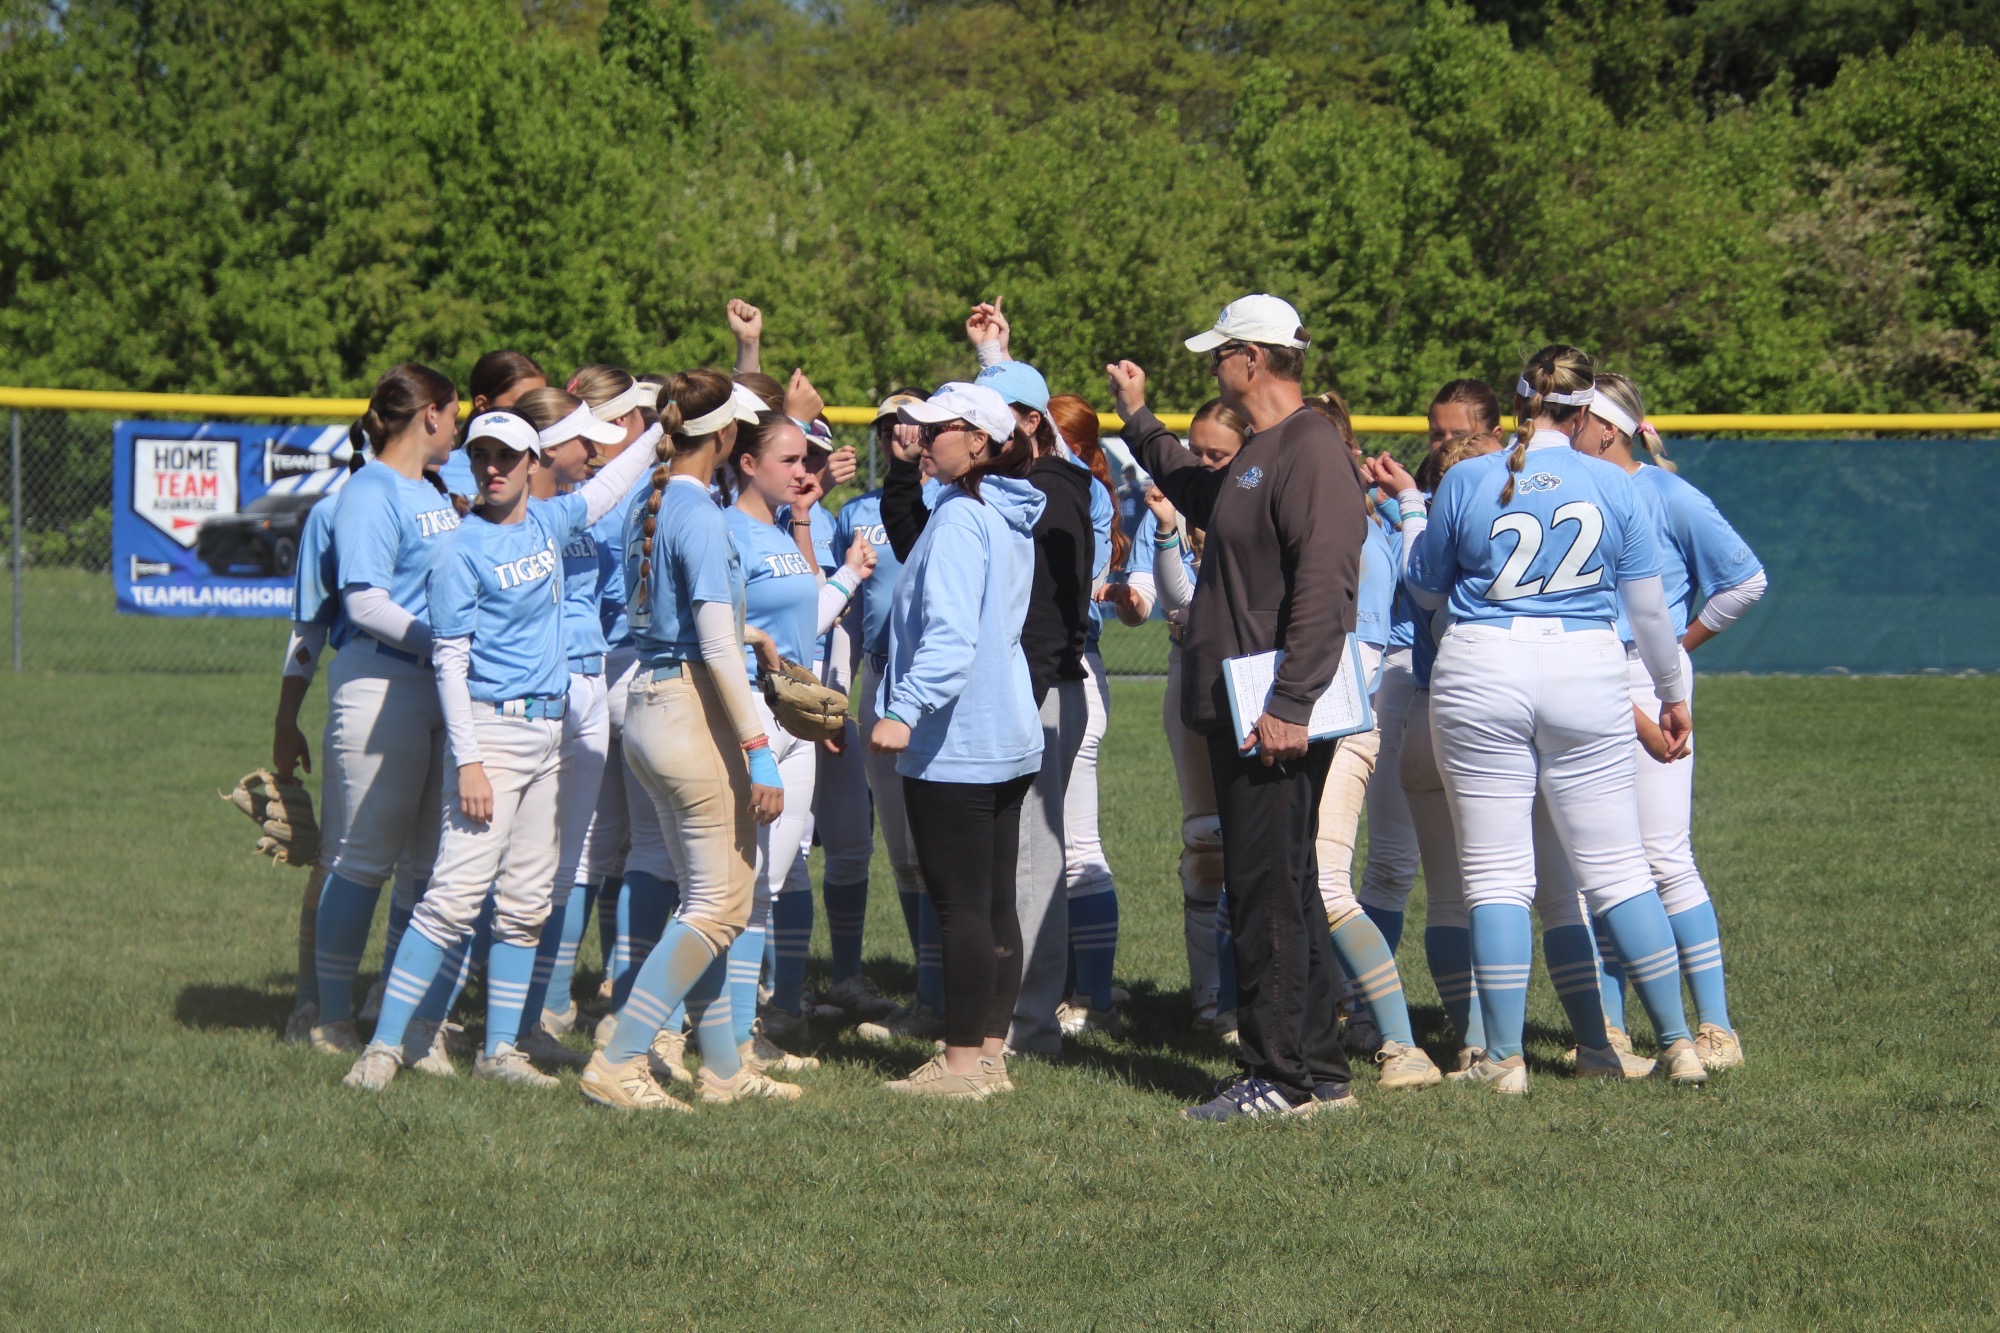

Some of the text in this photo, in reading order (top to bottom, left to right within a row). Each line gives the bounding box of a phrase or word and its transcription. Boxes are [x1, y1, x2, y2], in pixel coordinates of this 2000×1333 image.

[154, 446, 218, 471] HOME
[154, 472, 218, 498] TEAM
[1482, 500, 1605, 601] 22
